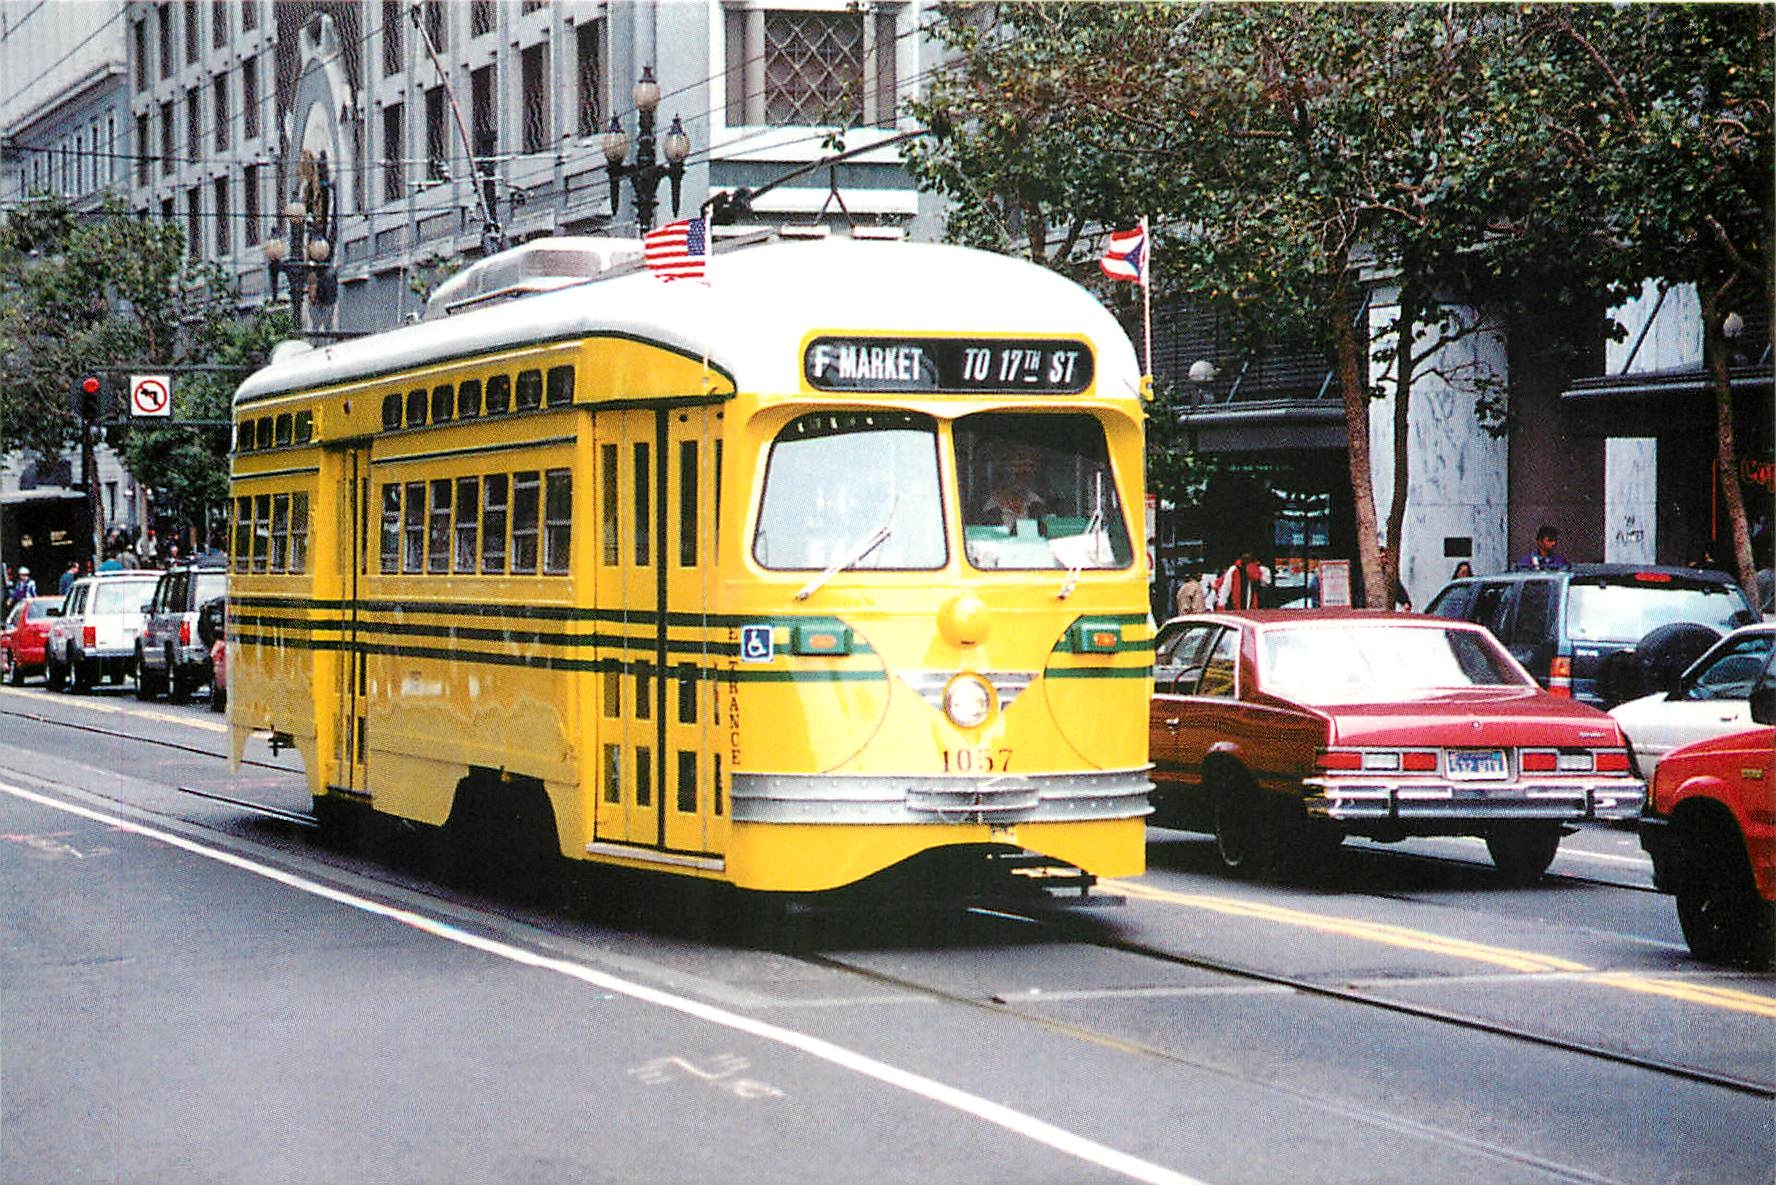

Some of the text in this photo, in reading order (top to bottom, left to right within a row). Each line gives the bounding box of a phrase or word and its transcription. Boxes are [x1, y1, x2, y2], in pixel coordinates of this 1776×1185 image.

[813, 344, 1079, 383] F MARKET TO 17TH ST
[727, 627, 742, 766] ETRANCE
[942, 748, 1014, 774] 1057
